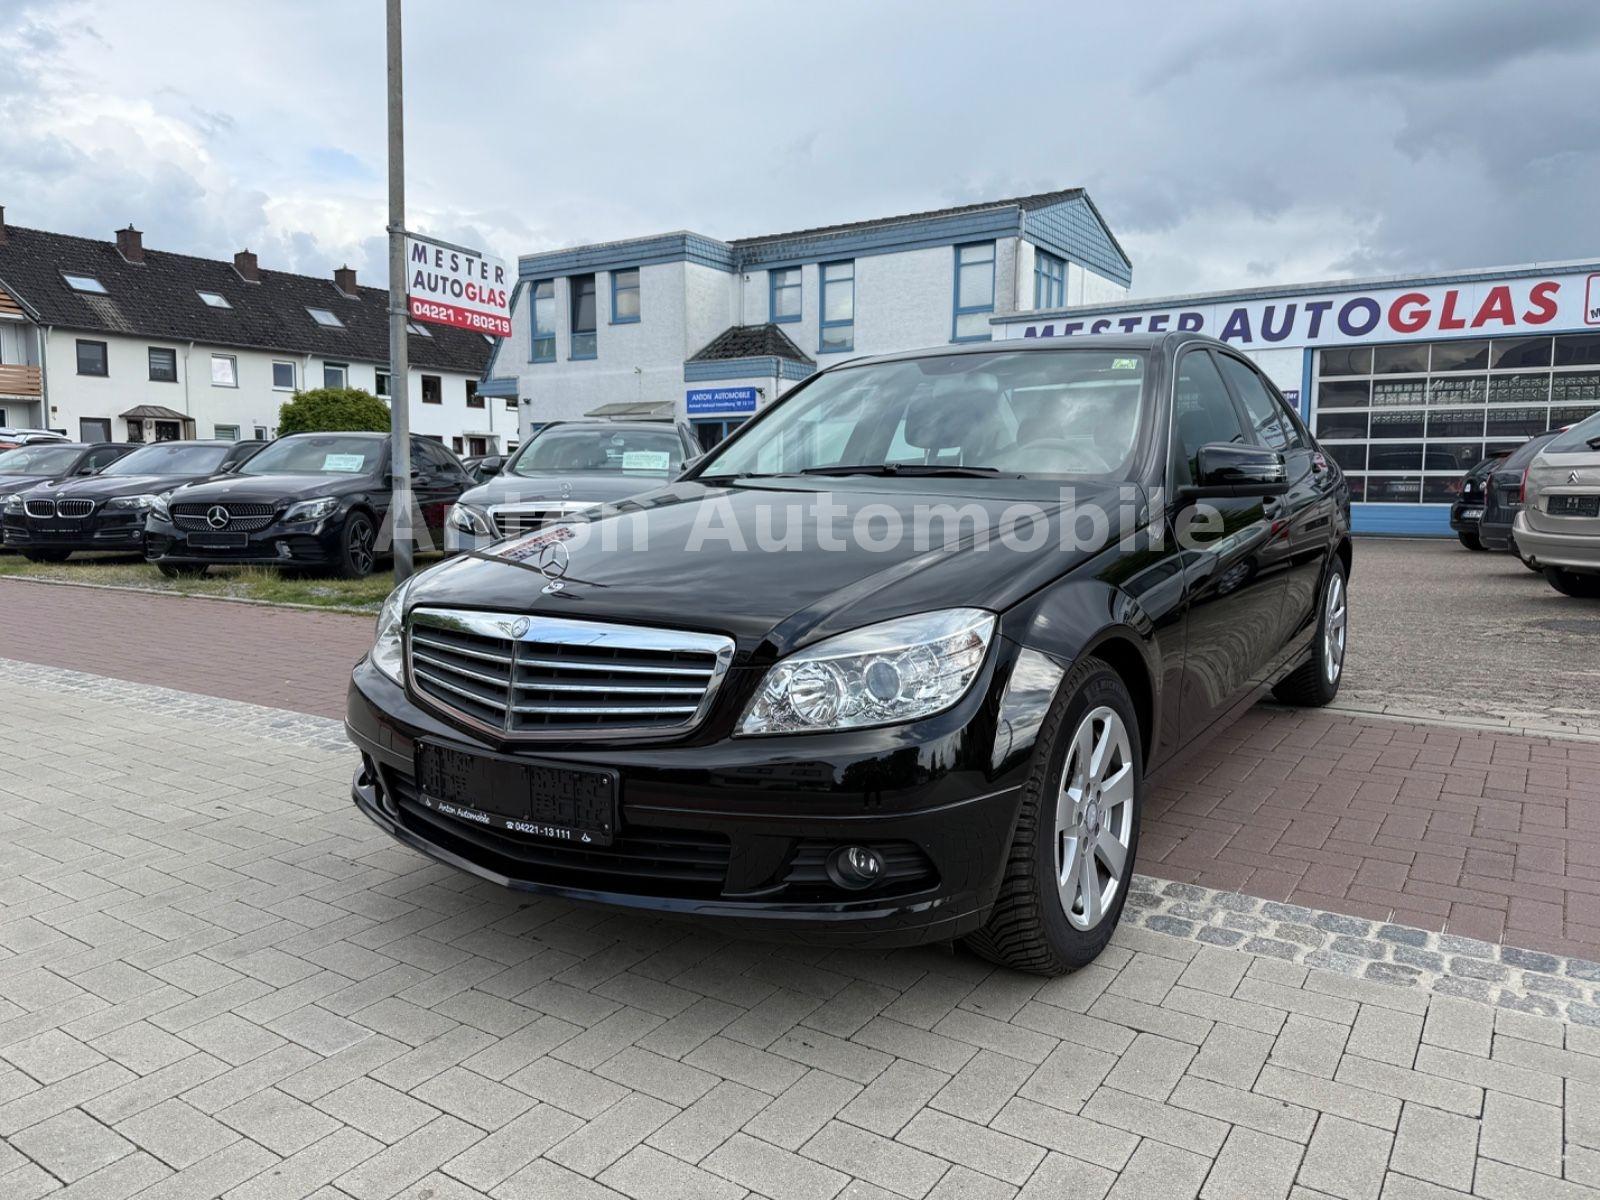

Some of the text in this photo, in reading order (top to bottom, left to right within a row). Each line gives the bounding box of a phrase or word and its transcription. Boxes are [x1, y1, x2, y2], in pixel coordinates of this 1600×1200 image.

[411, 243, 505, 285] MESTER
[413, 270, 507, 308] AUTOGLAS
[413, 301, 455, 322] 04221
[464, 312, 509, 332] 780219
[1220, 281, 1562, 343] AUTOGLAS
[692, 391, 751, 401] ANTON AUTOMOBILE
[438, 802, 491, 824] Anton Automobile
